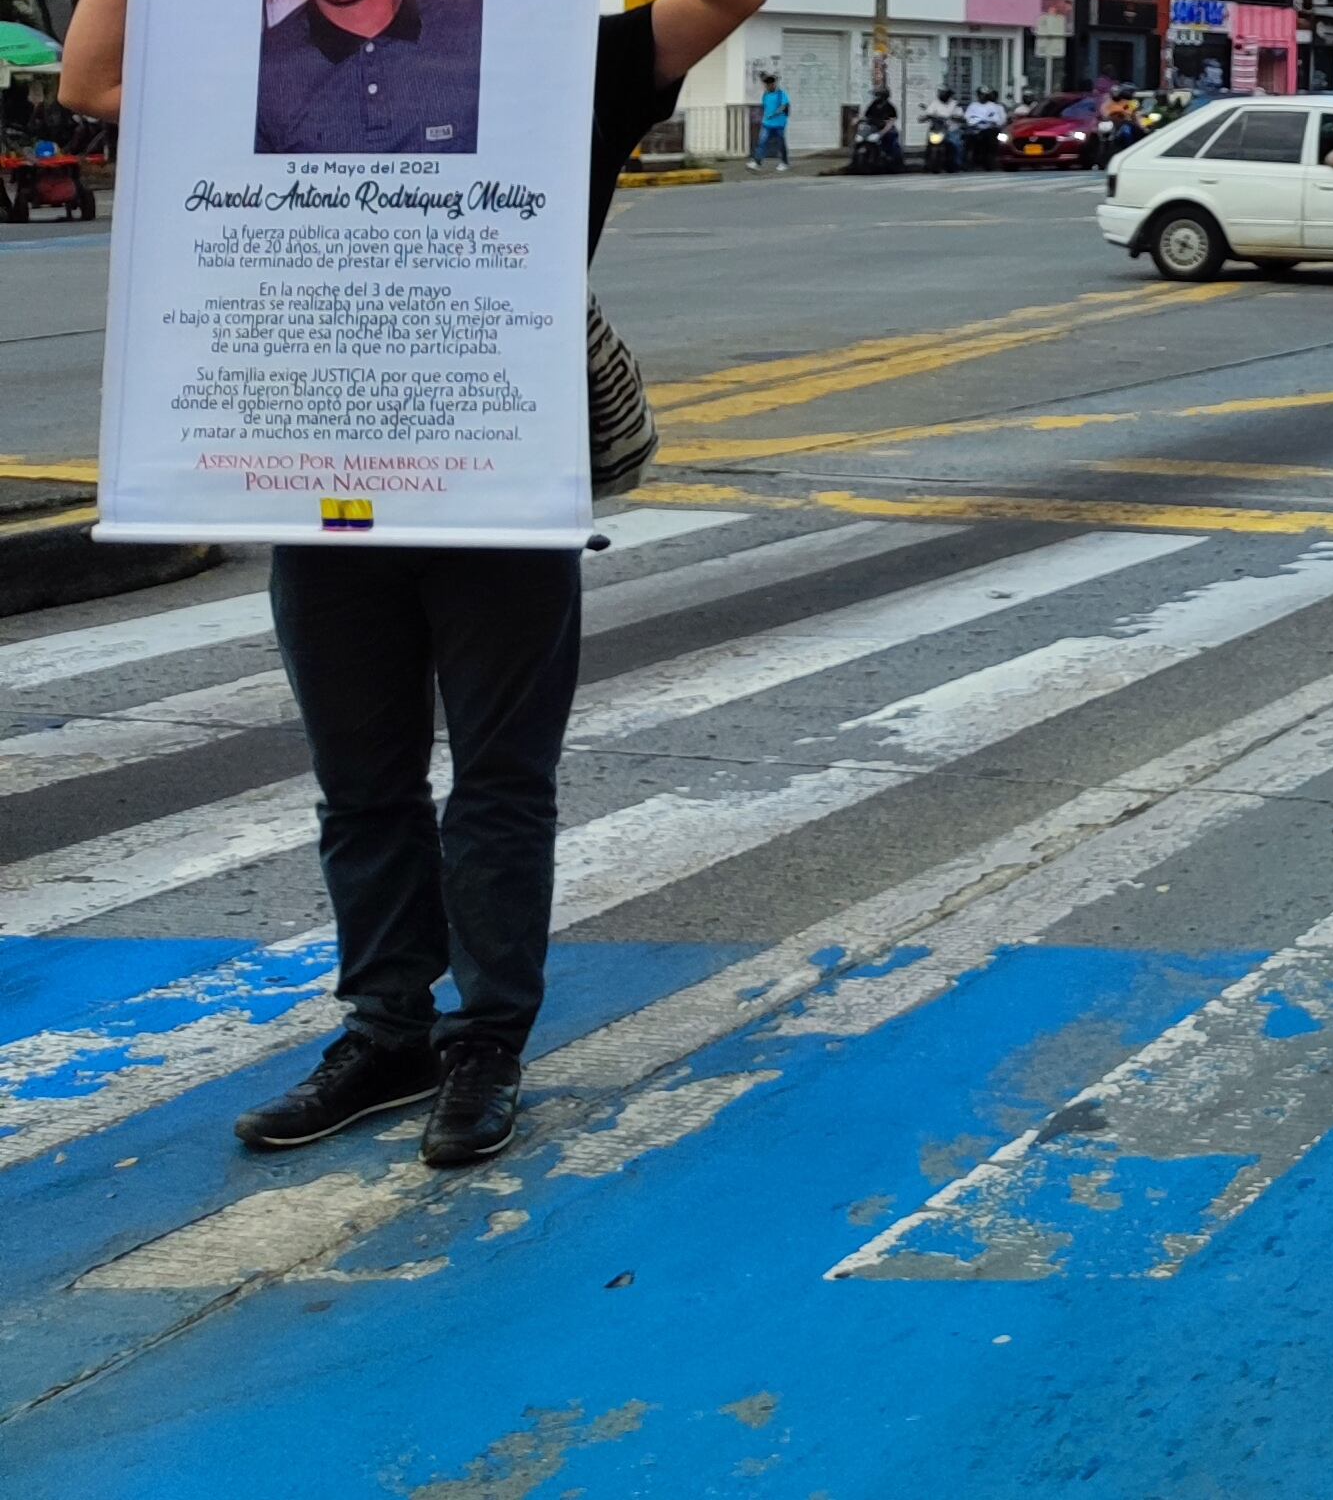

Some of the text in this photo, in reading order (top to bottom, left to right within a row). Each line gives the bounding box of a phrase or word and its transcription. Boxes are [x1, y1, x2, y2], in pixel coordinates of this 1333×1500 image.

[286, 162, 440, 177] 3 de Mayo del 2021
[185, 180, 262, 211] Harold
[265, 180, 350, 211] Antonio
[467, 180, 546, 220] Mellizo
[222, 226, 238, 240] La
[242, 226, 285, 243] fuerza
[344, 227, 389, 240] acabo
[394, 229, 421, 240] con
[426, 226, 439, 240] la
[444, 226, 475, 240] vida
[480, 227, 499, 240] de
